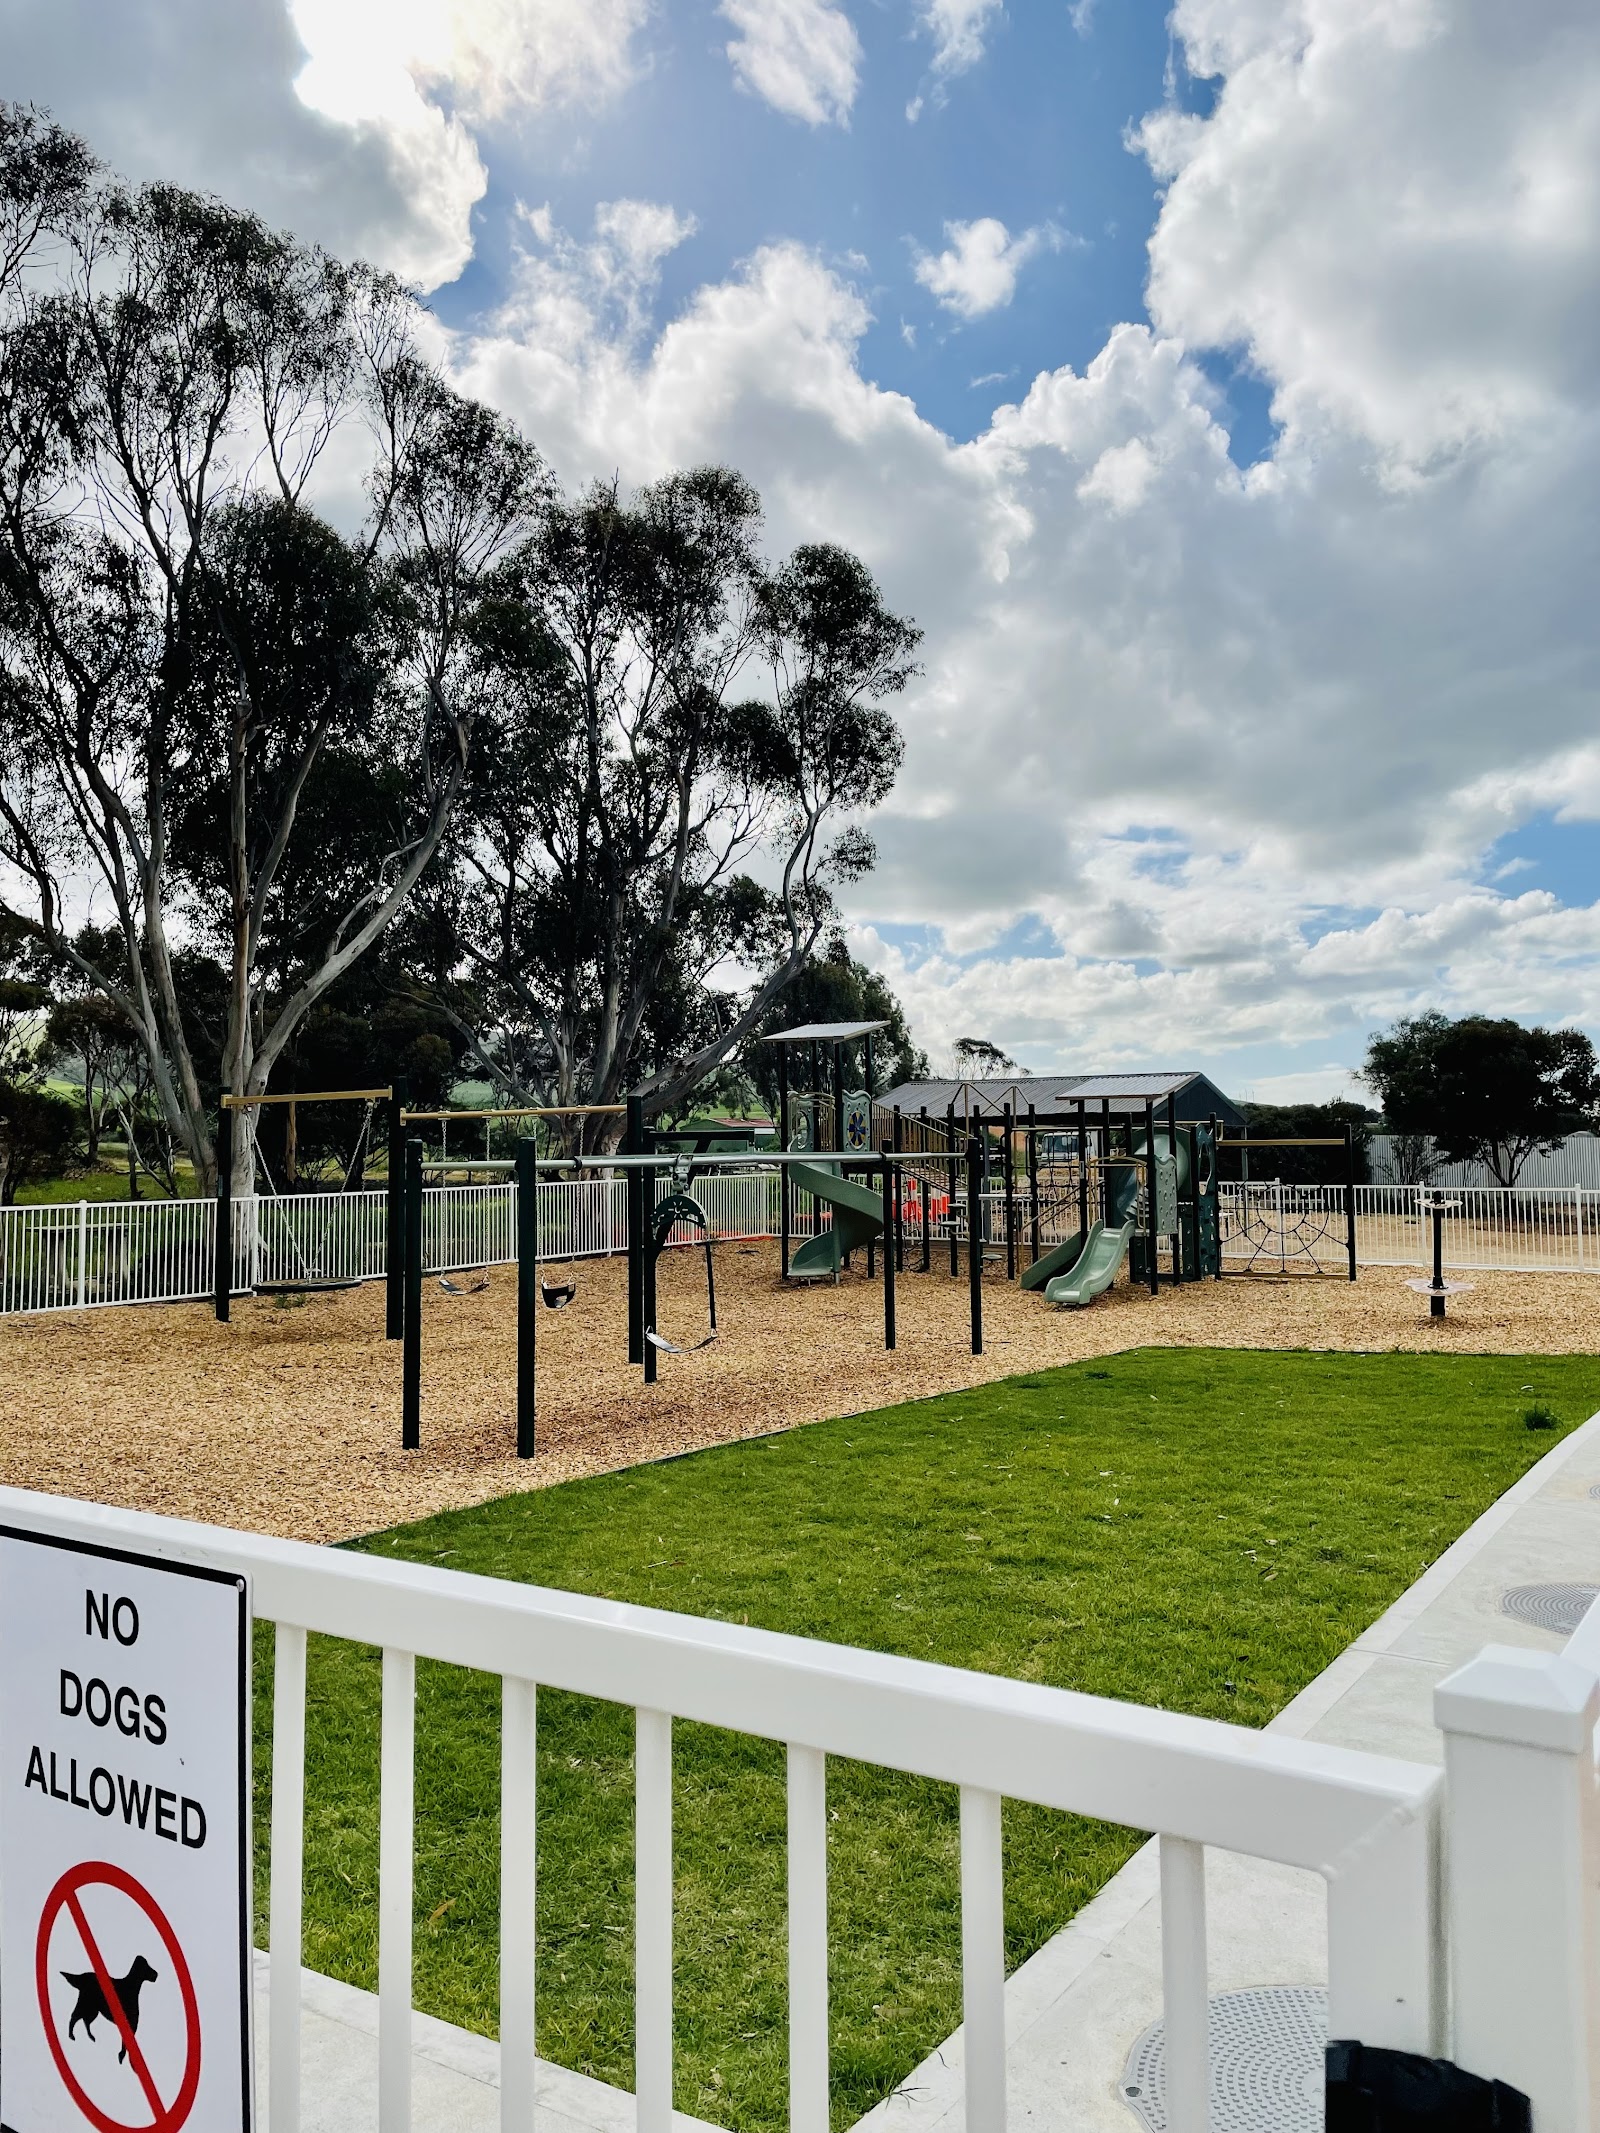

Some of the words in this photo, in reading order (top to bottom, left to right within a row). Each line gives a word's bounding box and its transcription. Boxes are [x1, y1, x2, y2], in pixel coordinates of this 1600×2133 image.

[85, 1589, 140, 1647] NO
[60, 1668, 167, 1746] DOGS
[24, 1745, 207, 1849] ALLOWED
